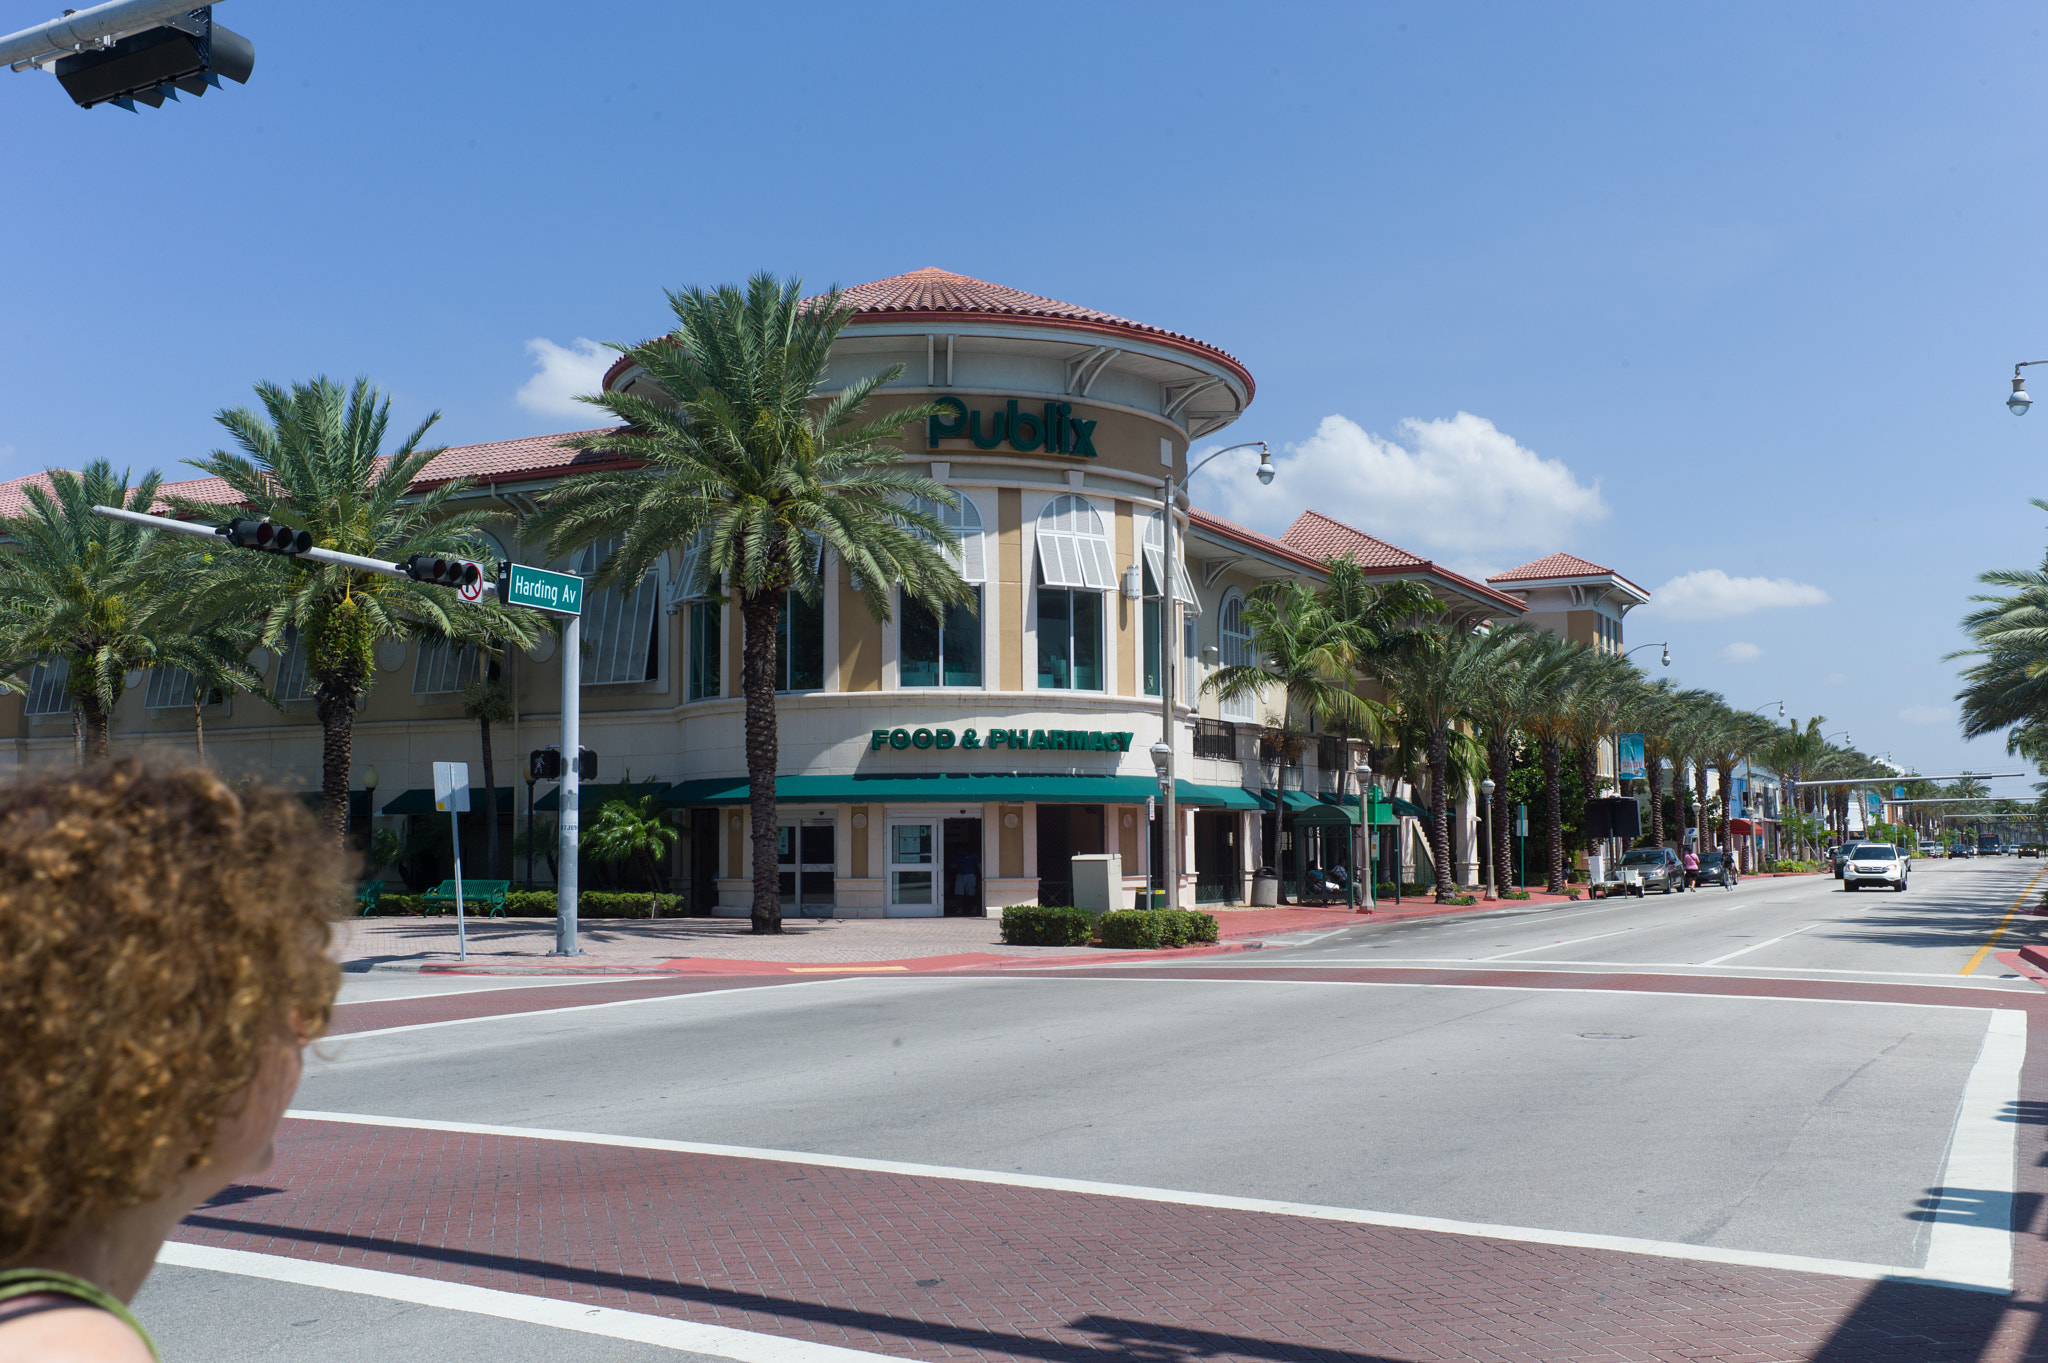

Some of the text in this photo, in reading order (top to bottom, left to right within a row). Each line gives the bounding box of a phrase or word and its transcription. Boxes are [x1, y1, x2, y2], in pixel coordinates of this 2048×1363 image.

[929, 396, 1098, 458] Publix
[515, 575, 576, 606] Harding Av
[871, 728, 1135, 752] FOOD & PHARMACY
